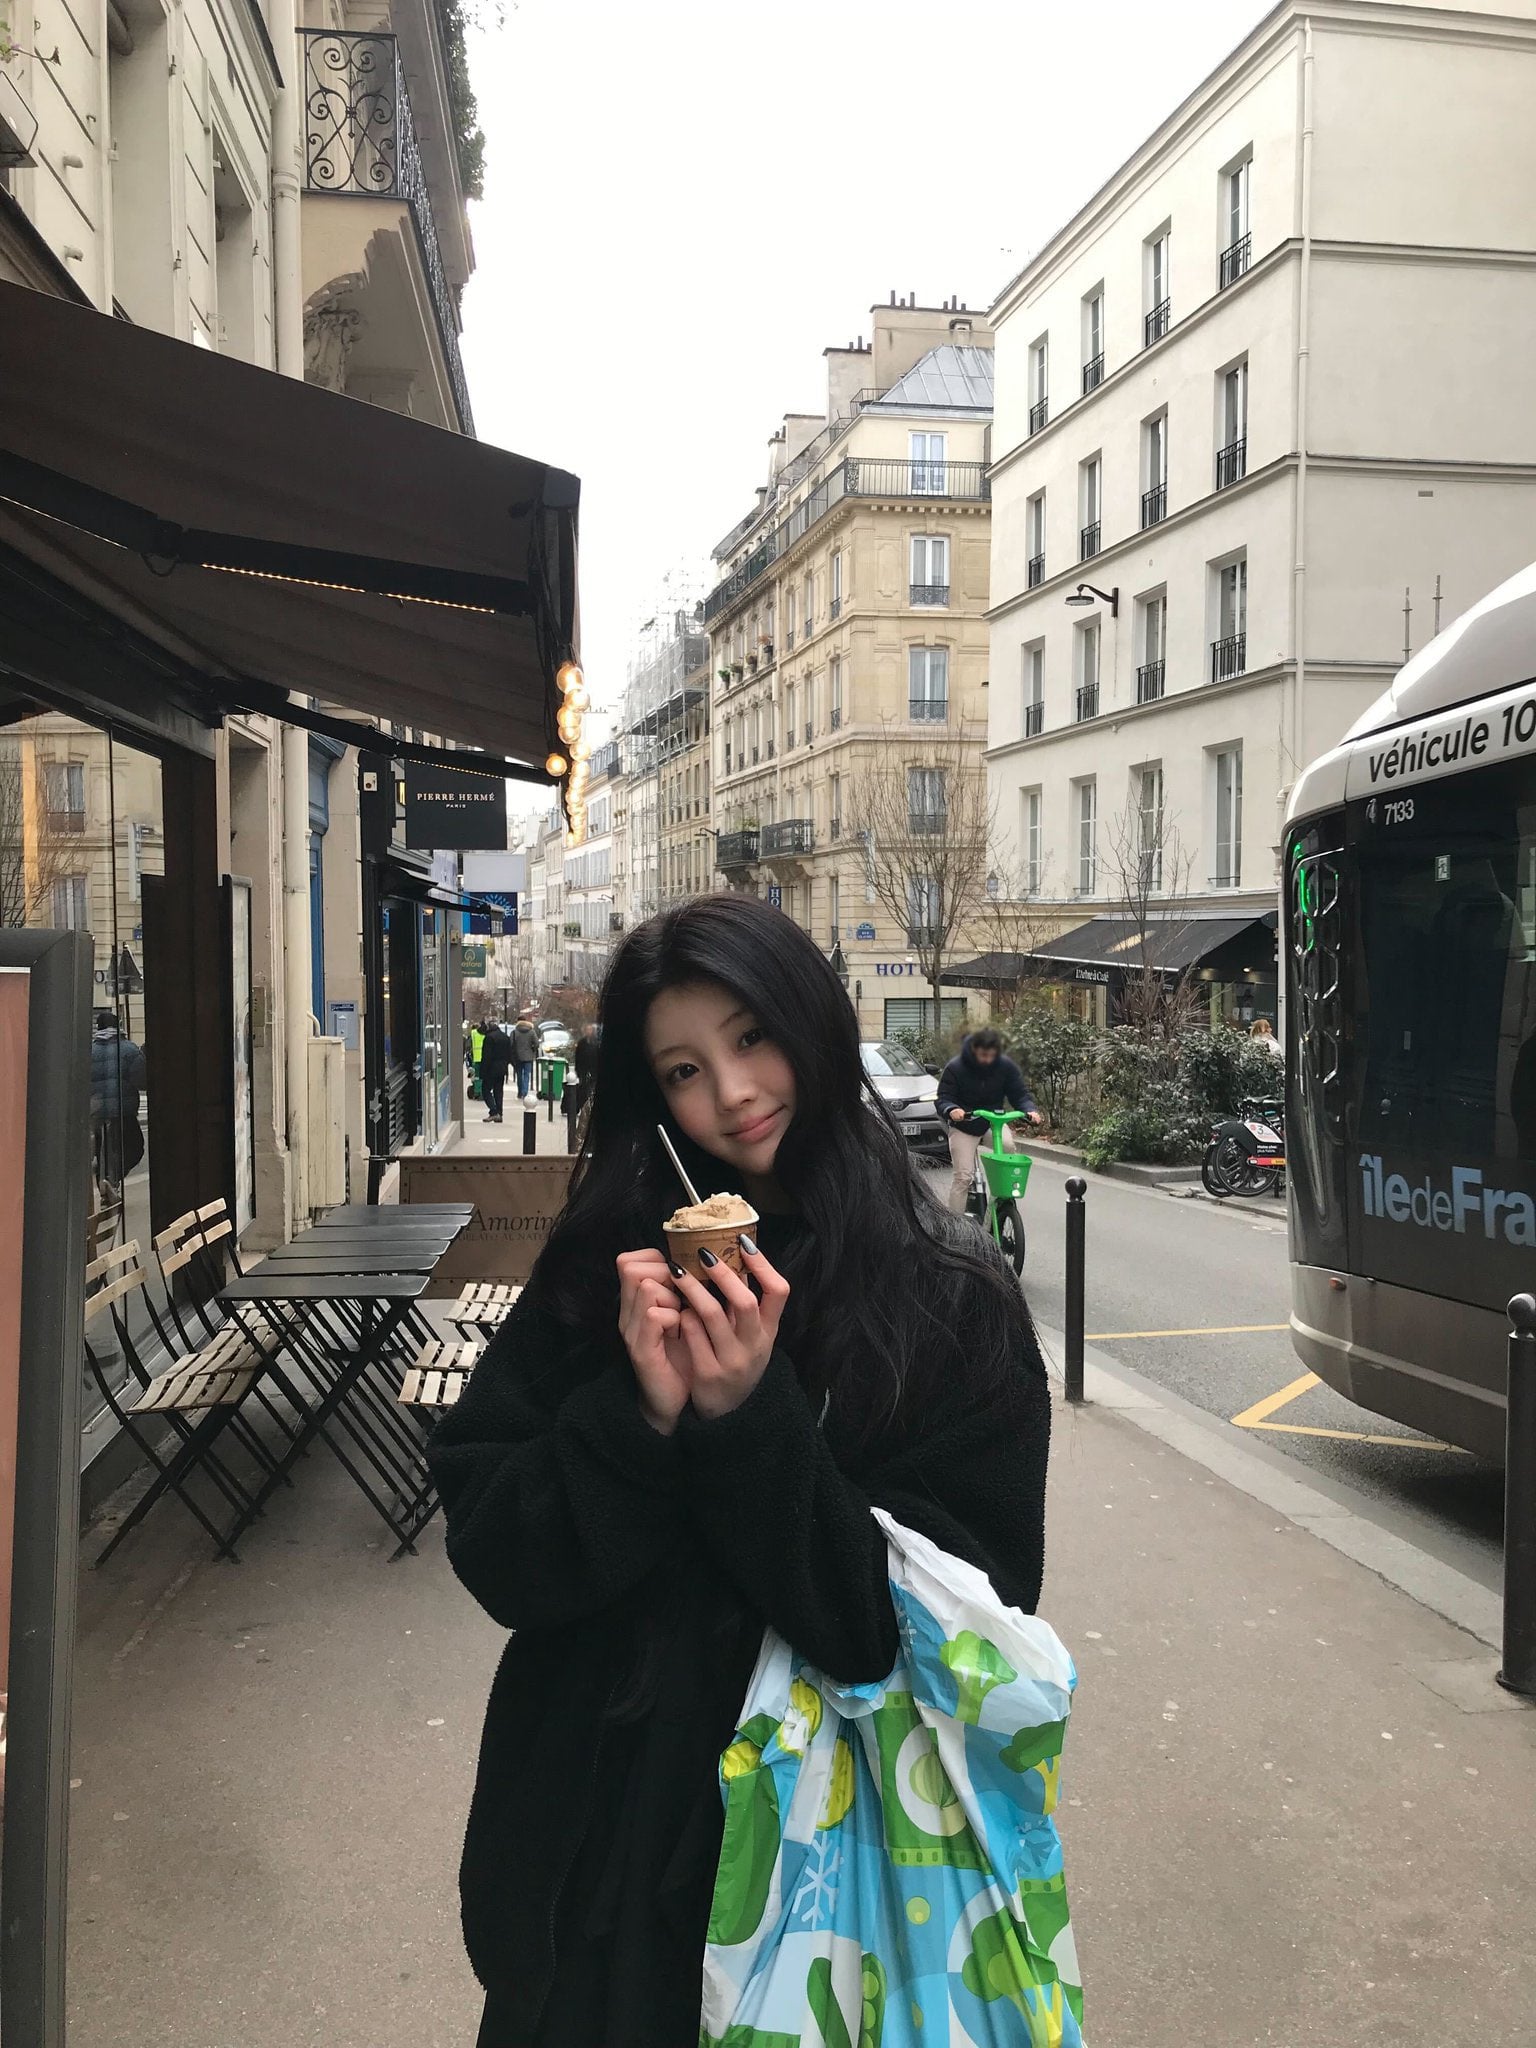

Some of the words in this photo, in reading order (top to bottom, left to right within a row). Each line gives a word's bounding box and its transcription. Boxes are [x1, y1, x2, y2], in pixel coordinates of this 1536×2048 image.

[1369, 717, 1489, 783] véhicule
[416, 792, 455, 801] PIERRE
[459, 791, 495, 801] HERMÉ
[1383, 798, 1415, 826] 7133
[876, 963, 924, 977] HOT
[467, 1208, 555, 1231] Amorin
